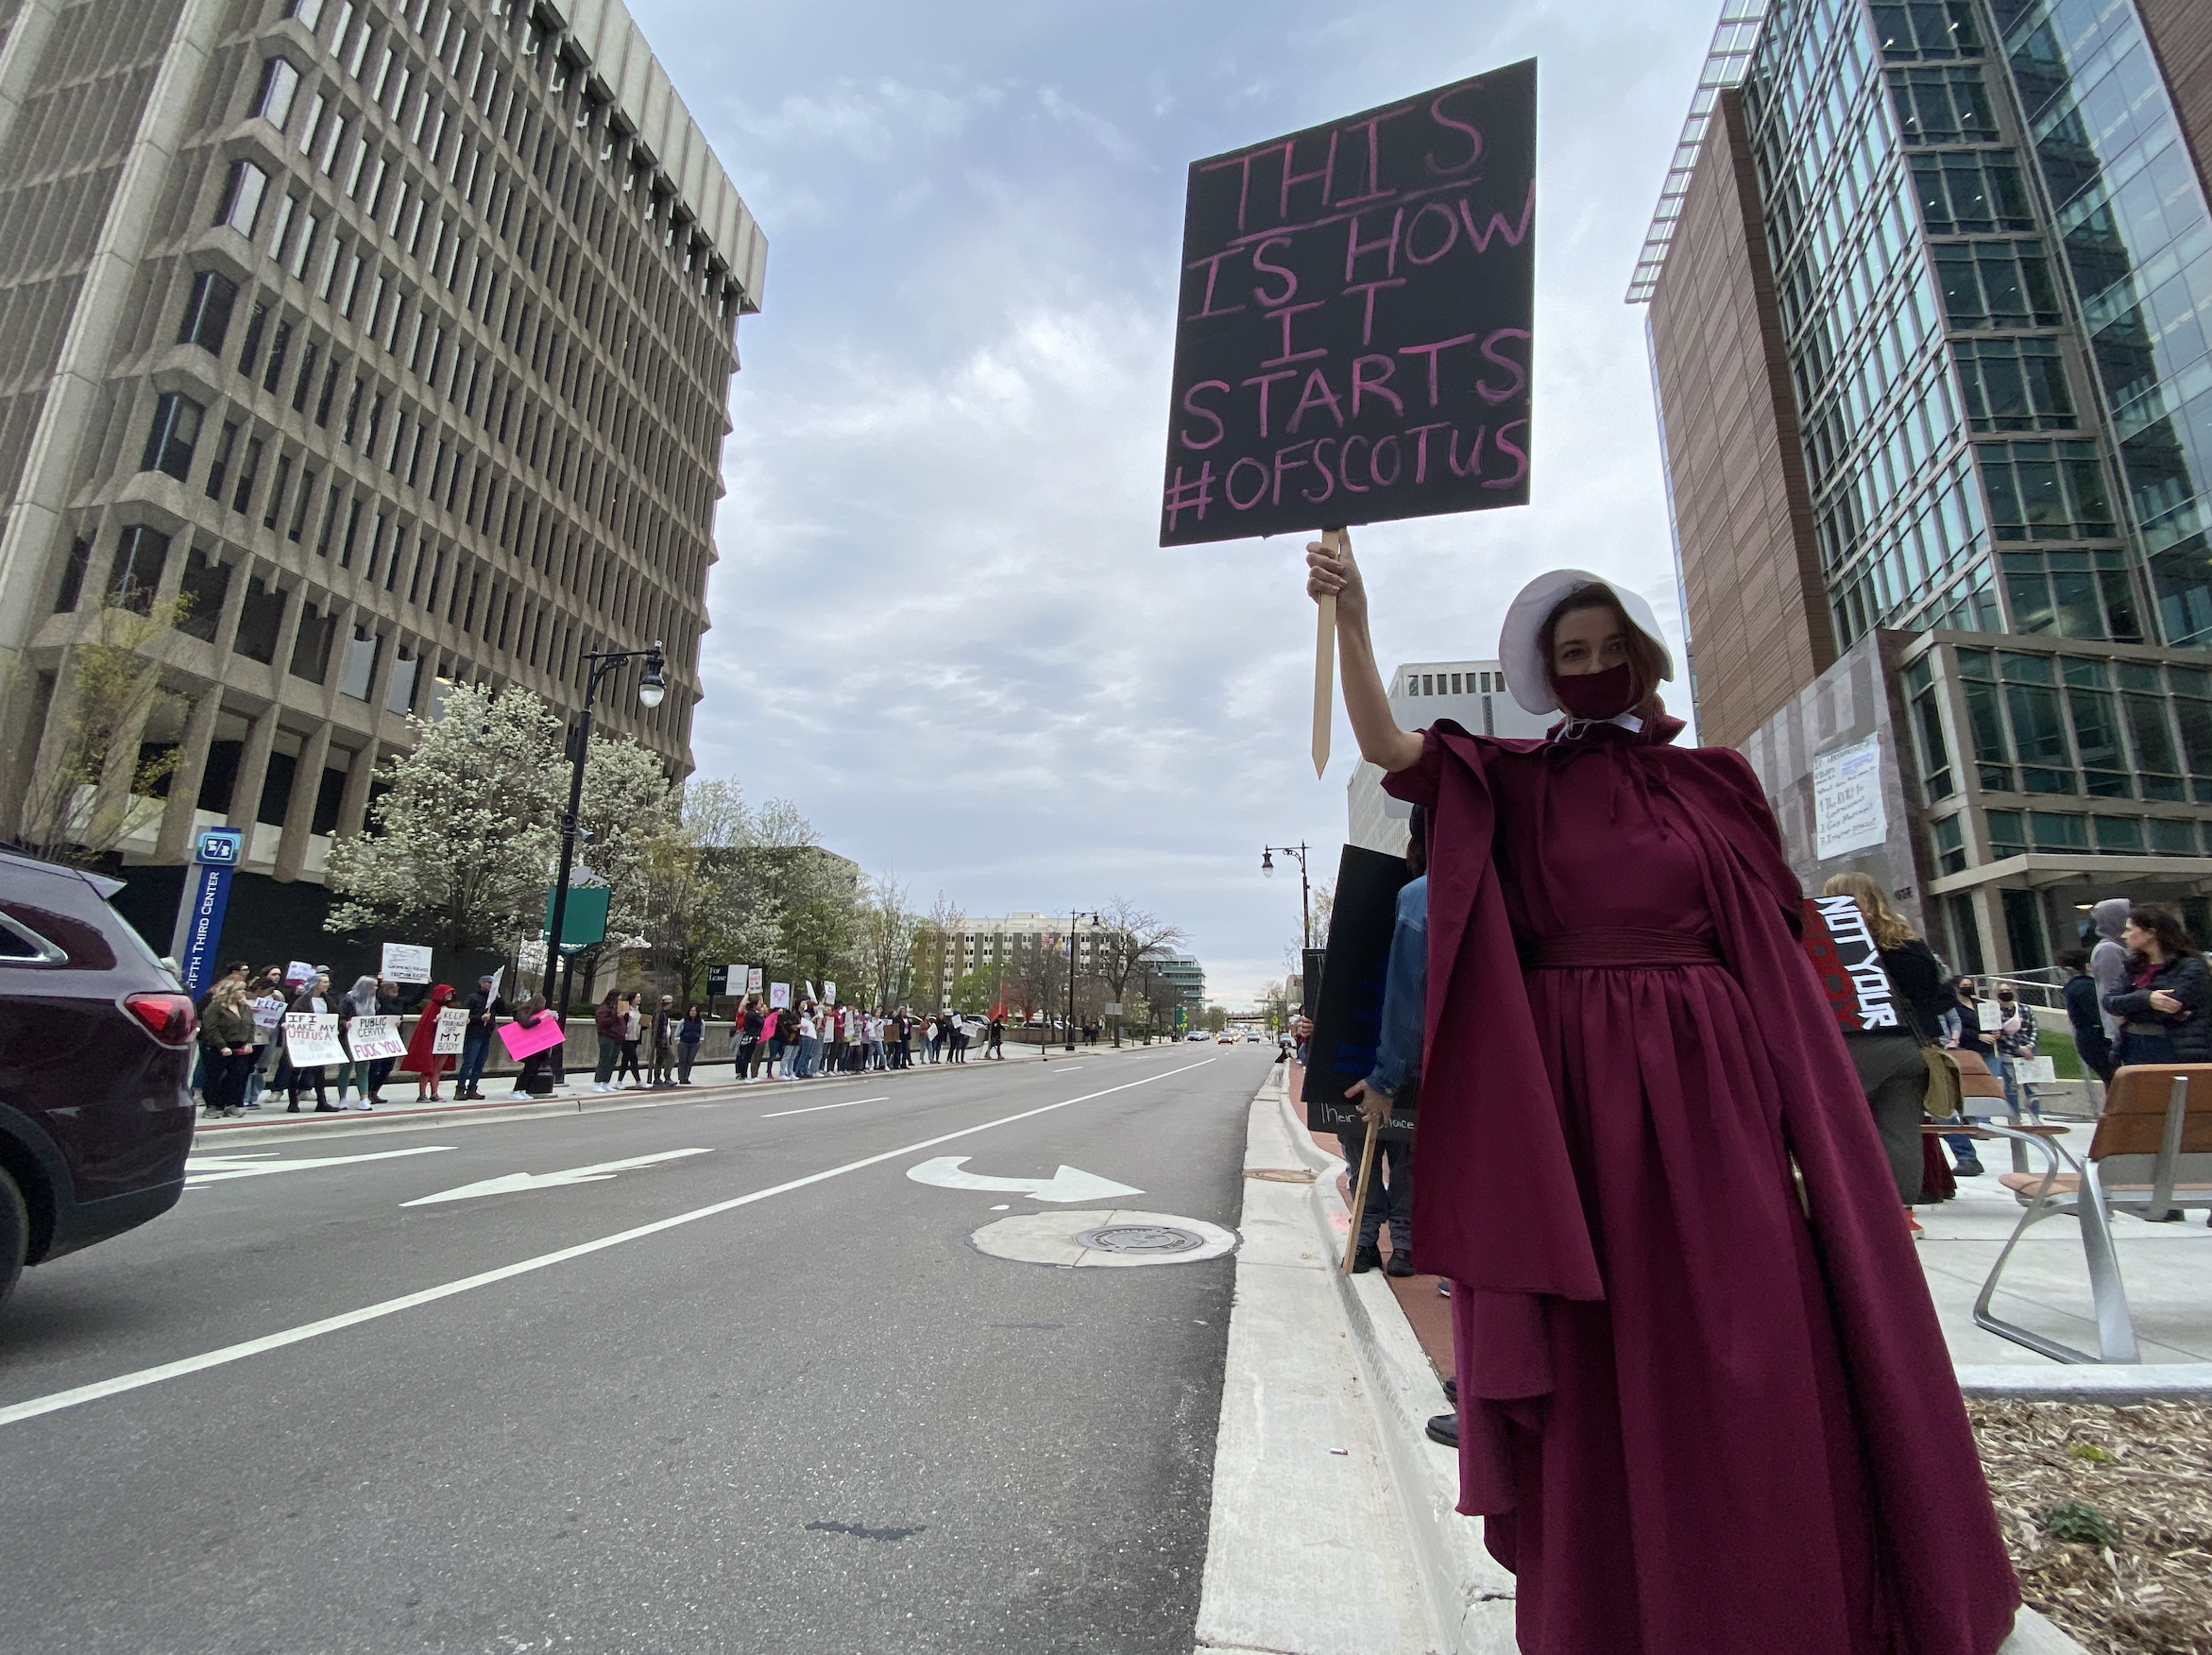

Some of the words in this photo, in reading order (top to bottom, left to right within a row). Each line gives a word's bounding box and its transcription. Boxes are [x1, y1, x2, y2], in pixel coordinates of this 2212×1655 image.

[1199, 81, 1485, 231] THIS
[1186, 236, 1298, 321] IS
[1345, 177, 1537, 282] HOW
[1260, 277, 1407, 368] IT
[1181, 328, 1531, 451] STARTS
[1166, 418, 1530, 533] #OFSCOTUS
[200, 871, 220, 915] CENTER
[1814, 896, 1876, 952] NOT
[192, 917, 210, 954] THIRD
[1844, 949, 1898, 1031] YOUR
[257, 999, 283, 1012] KEEP
[288, 1015, 306, 1023] IF
[360, 1016, 387, 1028] PUBLIC
[444, 1011, 465, 1020] KEEP
[287, 1023, 315, 1032] MAKE
[320, 1024, 335, 1032] MY
[288, 1030, 323, 1040] UTERUS
[325, 1032, 332, 1041] A
[357, 1027, 386, 1038] CERVIX
[440, 1032, 460, 1042] MY
[354, 1042, 382, 1058] FUCK
[378, 1040, 402, 1053] YOU
[437, 1042, 460, 1051] BODY
